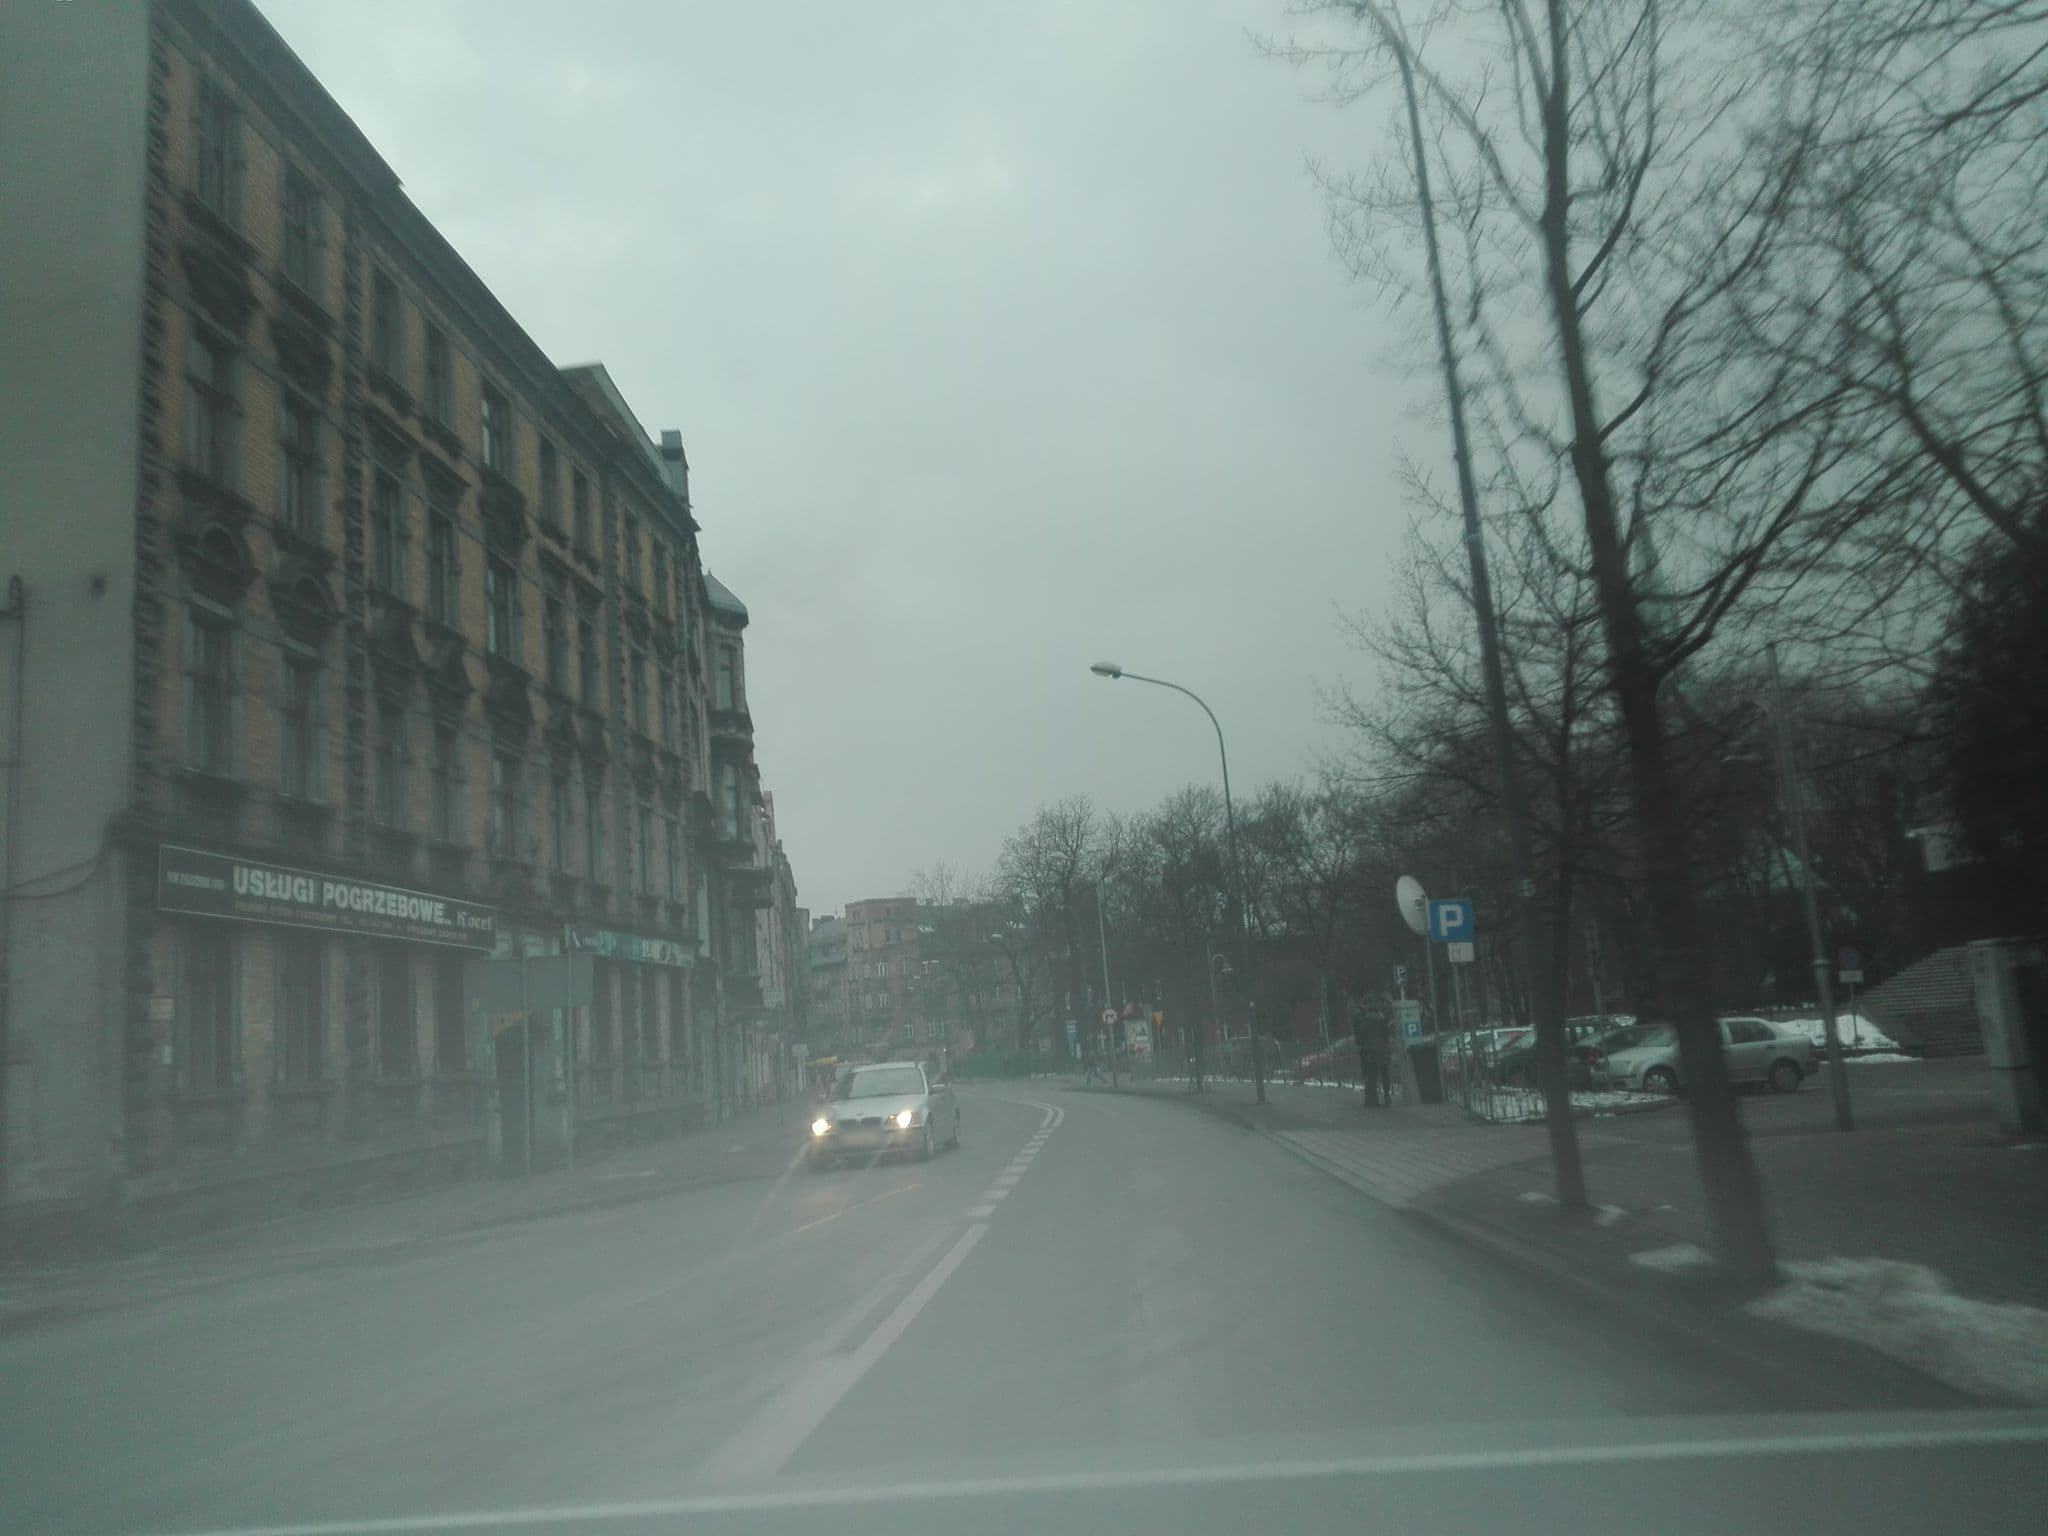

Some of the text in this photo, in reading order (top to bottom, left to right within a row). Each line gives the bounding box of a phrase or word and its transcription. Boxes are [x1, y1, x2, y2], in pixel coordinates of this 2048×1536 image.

[233, 865, 315, 905] USŁUGI
[322, 881, 447, 926] POGRZEBOWE
[1439, 903, 1464, 936] P
[1408, 1023, 1417, 1035] P
